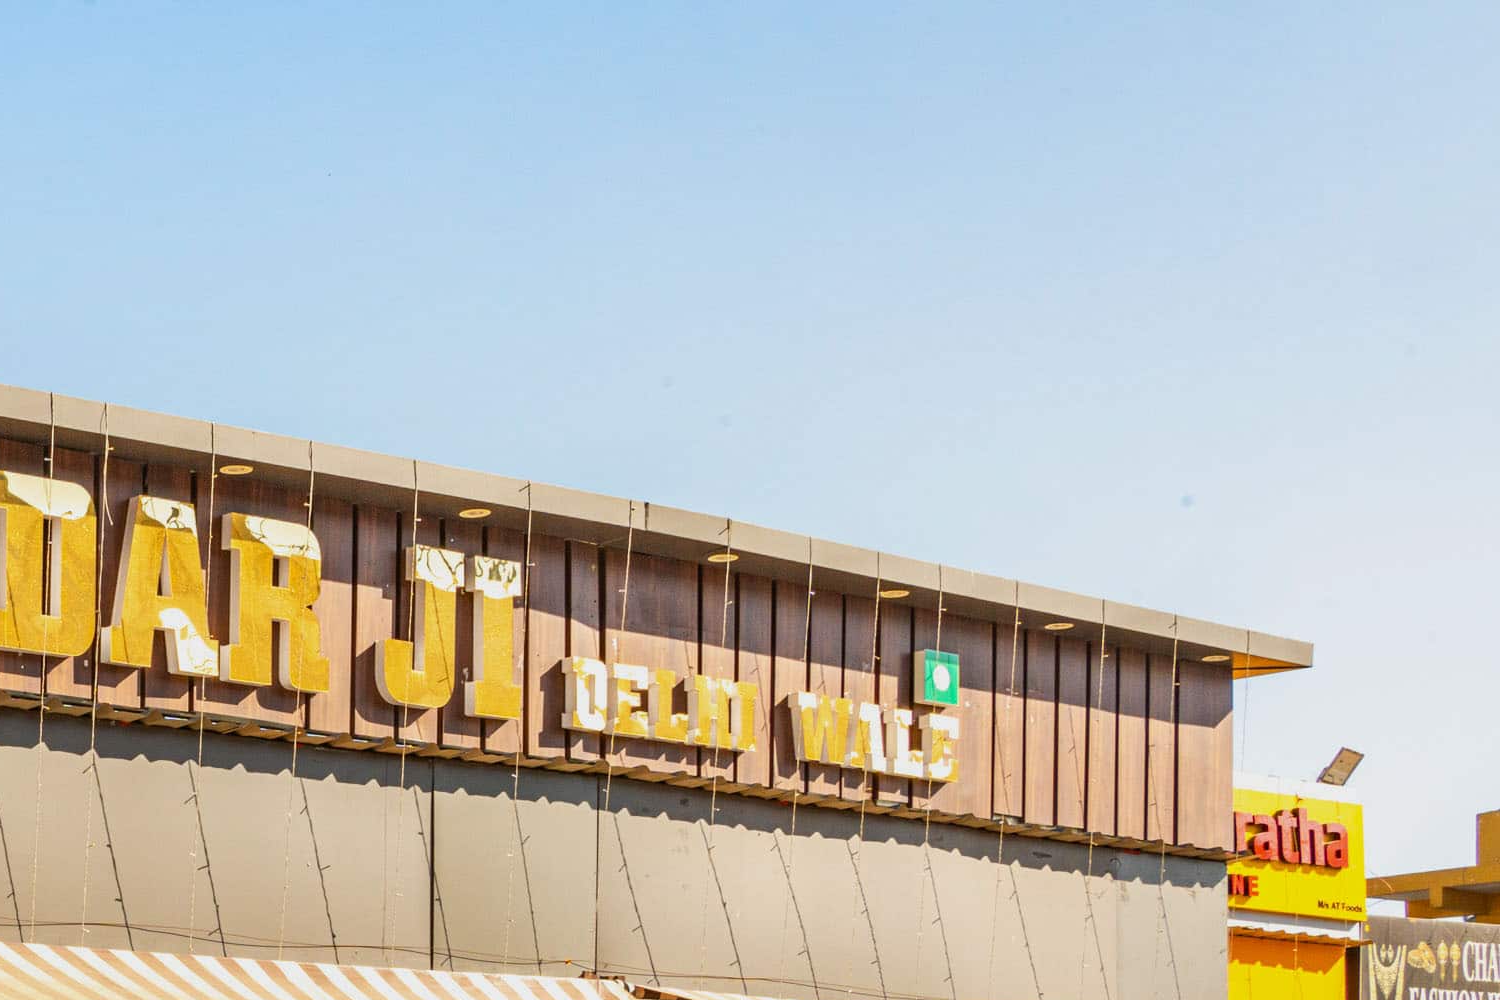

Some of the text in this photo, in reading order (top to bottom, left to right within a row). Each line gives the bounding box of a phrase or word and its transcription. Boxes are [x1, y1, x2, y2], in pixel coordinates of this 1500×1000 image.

[375, 544, 522, 720] JI
[562, 656, 960, 783] DELHI WALE
[1342, 902, 1363, 913] Foods
[1462, 941, 1500, 982] CHA
